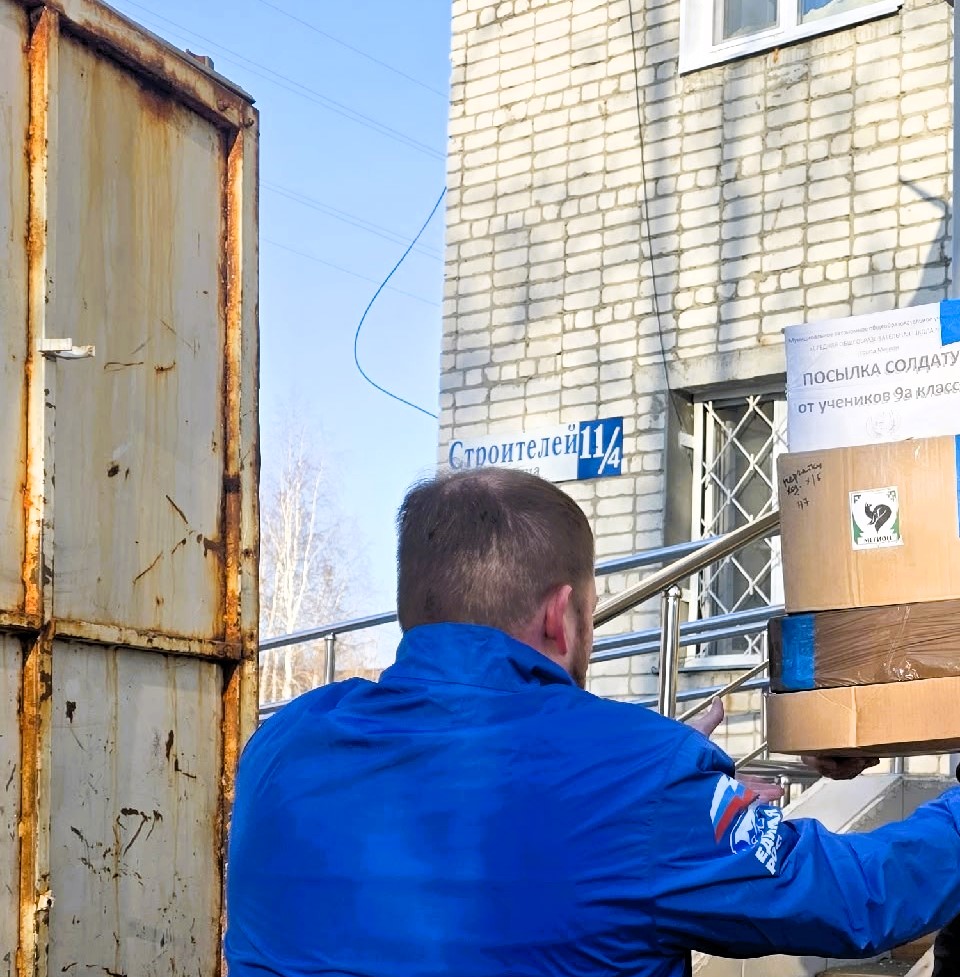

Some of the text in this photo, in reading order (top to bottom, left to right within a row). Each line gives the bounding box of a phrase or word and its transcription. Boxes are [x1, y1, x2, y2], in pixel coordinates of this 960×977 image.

[803, 362, 881, 386] ПОСЫЛКА
[885, 351, 960, 374] СОЛДАТУ
[798, 402, 814, 414] от
[818, 391, 890, 414] учеников
[895, 386, 912, 401] 9а
[449, 424, 579, 470] Строителей
